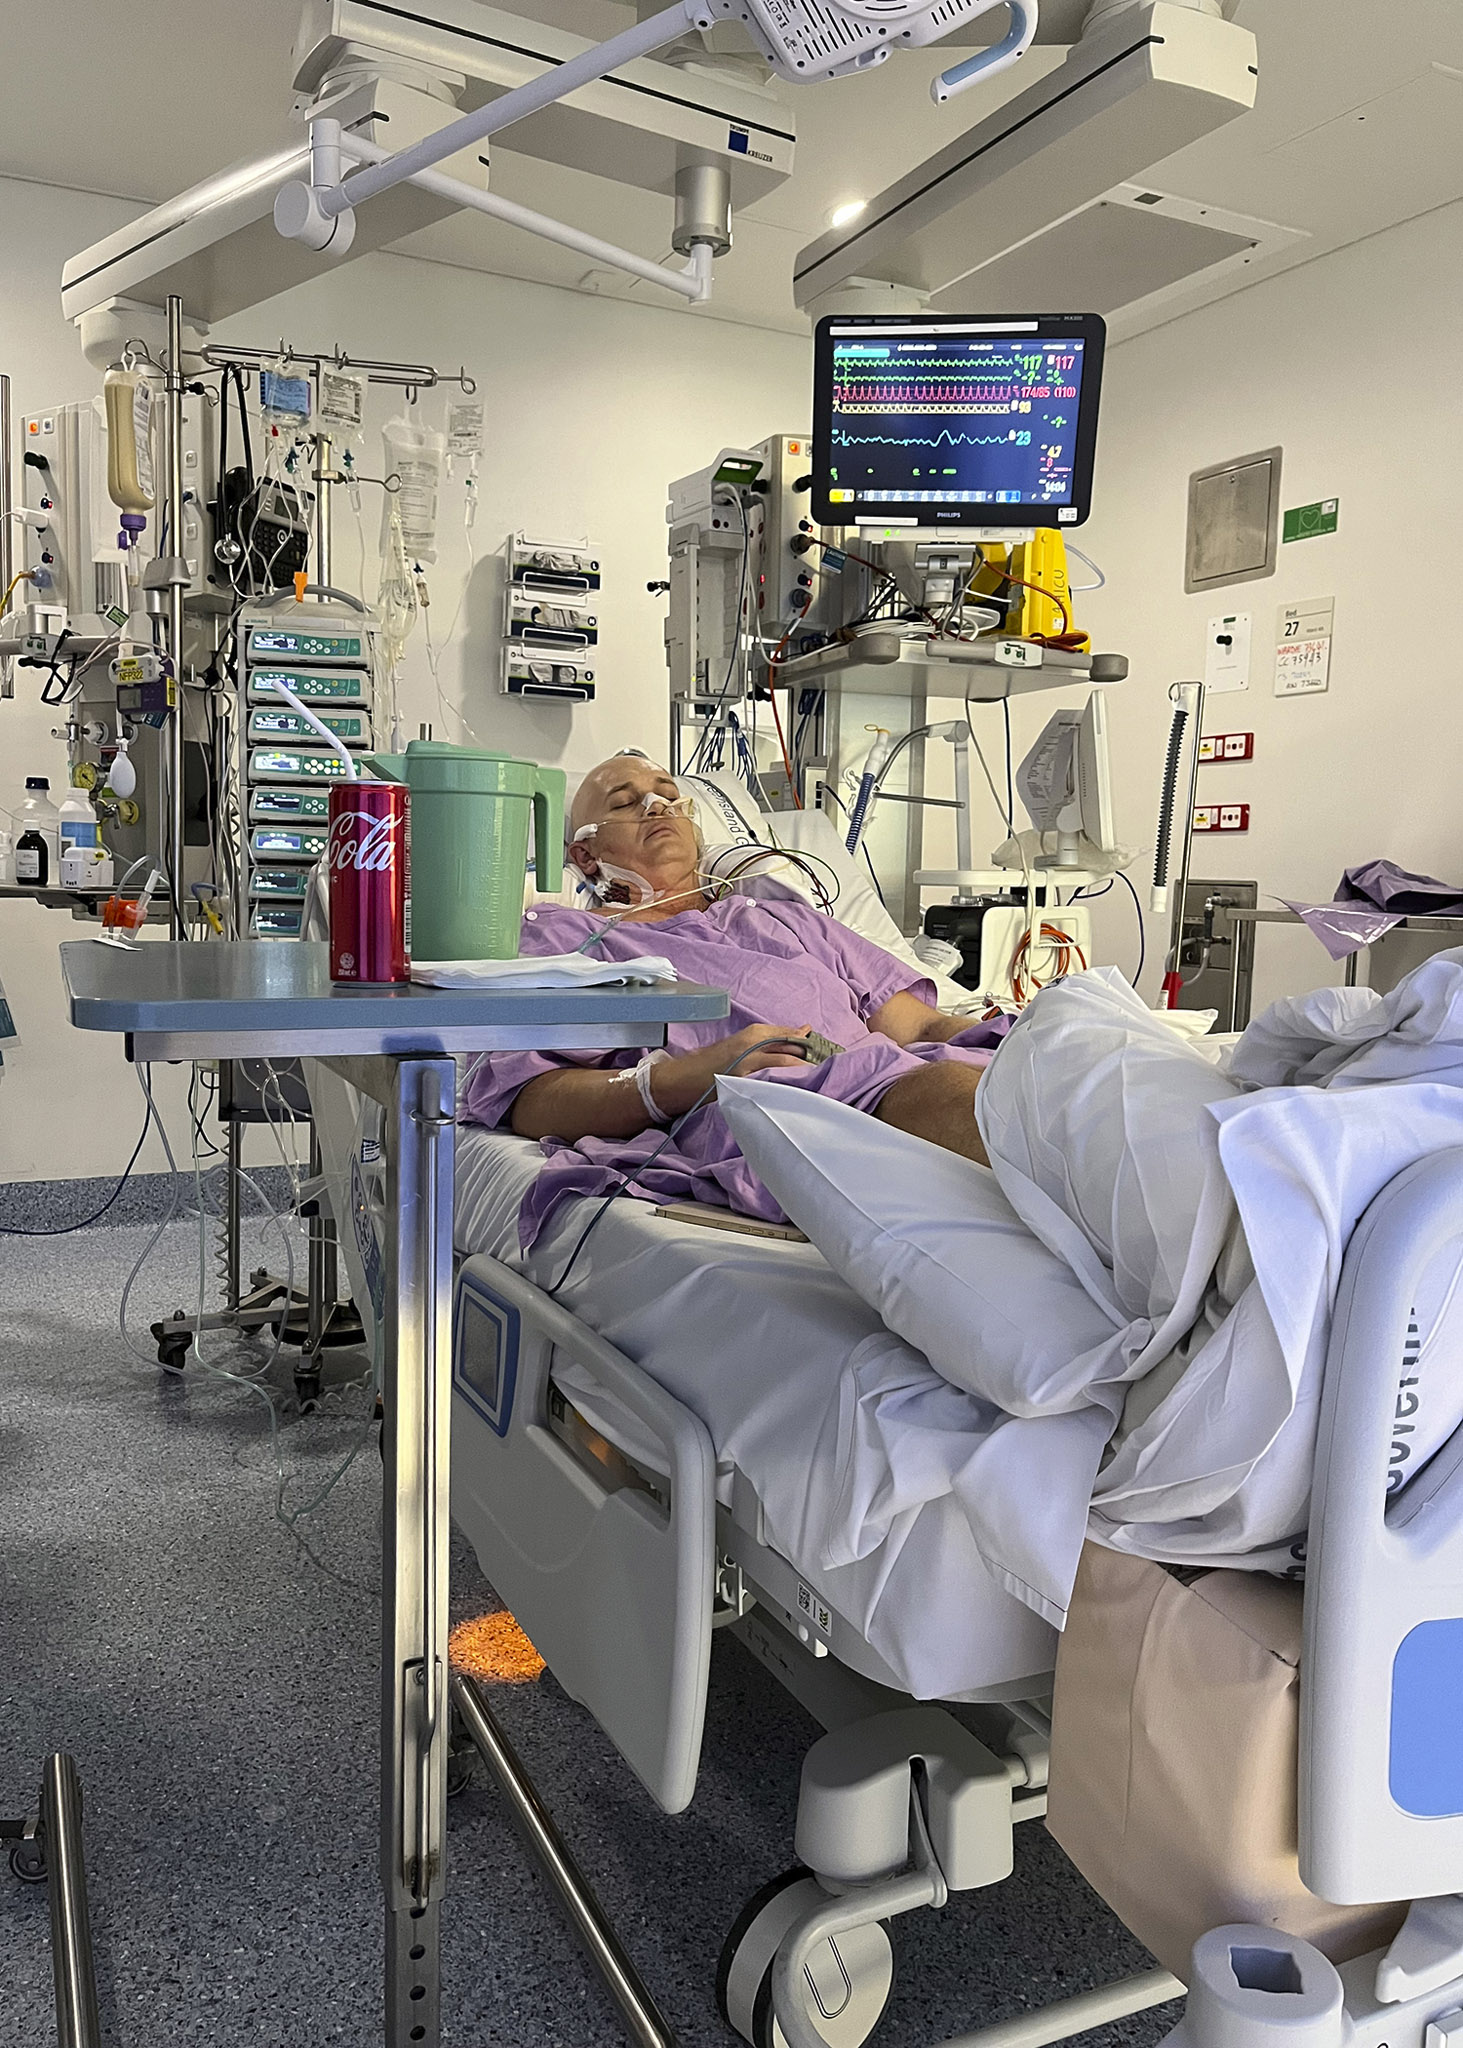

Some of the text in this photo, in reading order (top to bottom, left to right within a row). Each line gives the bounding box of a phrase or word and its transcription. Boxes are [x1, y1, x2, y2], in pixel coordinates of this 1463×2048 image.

[748, 150, 773, 162] KREUZER
[1021, 354, 1043, 371] 117
[1055, 355, 1075, 370] 117
[1015, 430, 1031, 446] 23
[1285, 609, 1297, 617] Bed
[1284, 621, 1300, 637] 27
[329, 811, 404, 872] Cola
